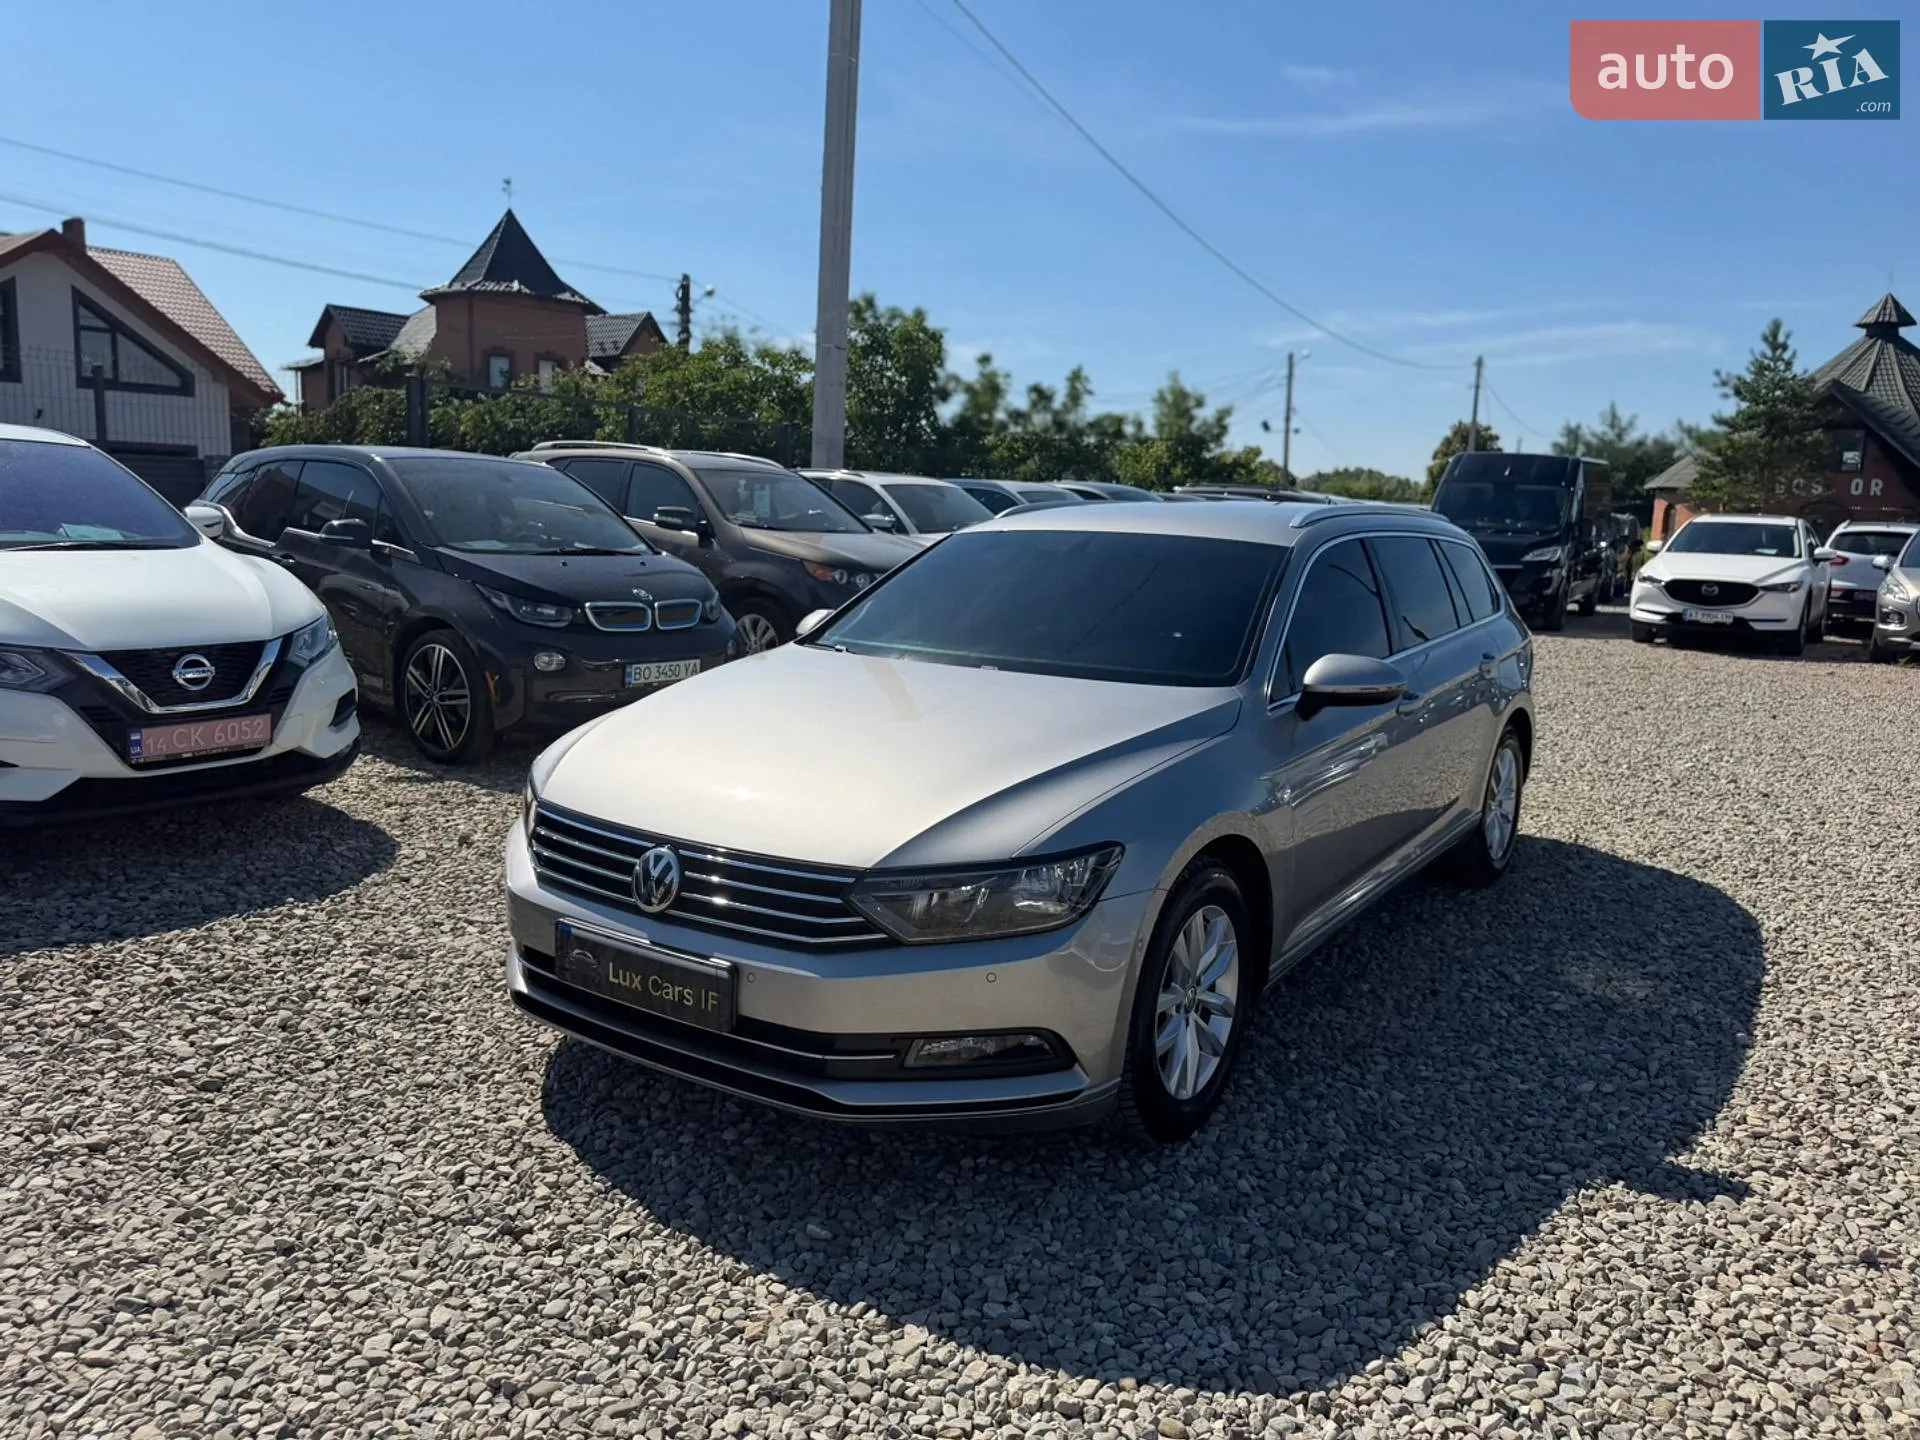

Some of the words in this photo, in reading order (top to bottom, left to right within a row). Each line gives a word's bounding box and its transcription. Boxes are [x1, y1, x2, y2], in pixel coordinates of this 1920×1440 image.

[632, 666, 651, 682] BO
[654, 664, 681, 680] 3450
[684, 662, 700, 677] YA
[146, 737, 167, 753] 14
[172, 726, 205, 749] CK
[214, 719, 264, 744] 6052
[608, 961, 643, 992] Lux
[648, 975, 694, 1006] Cars
[701, 987, 720, 1012] IF
